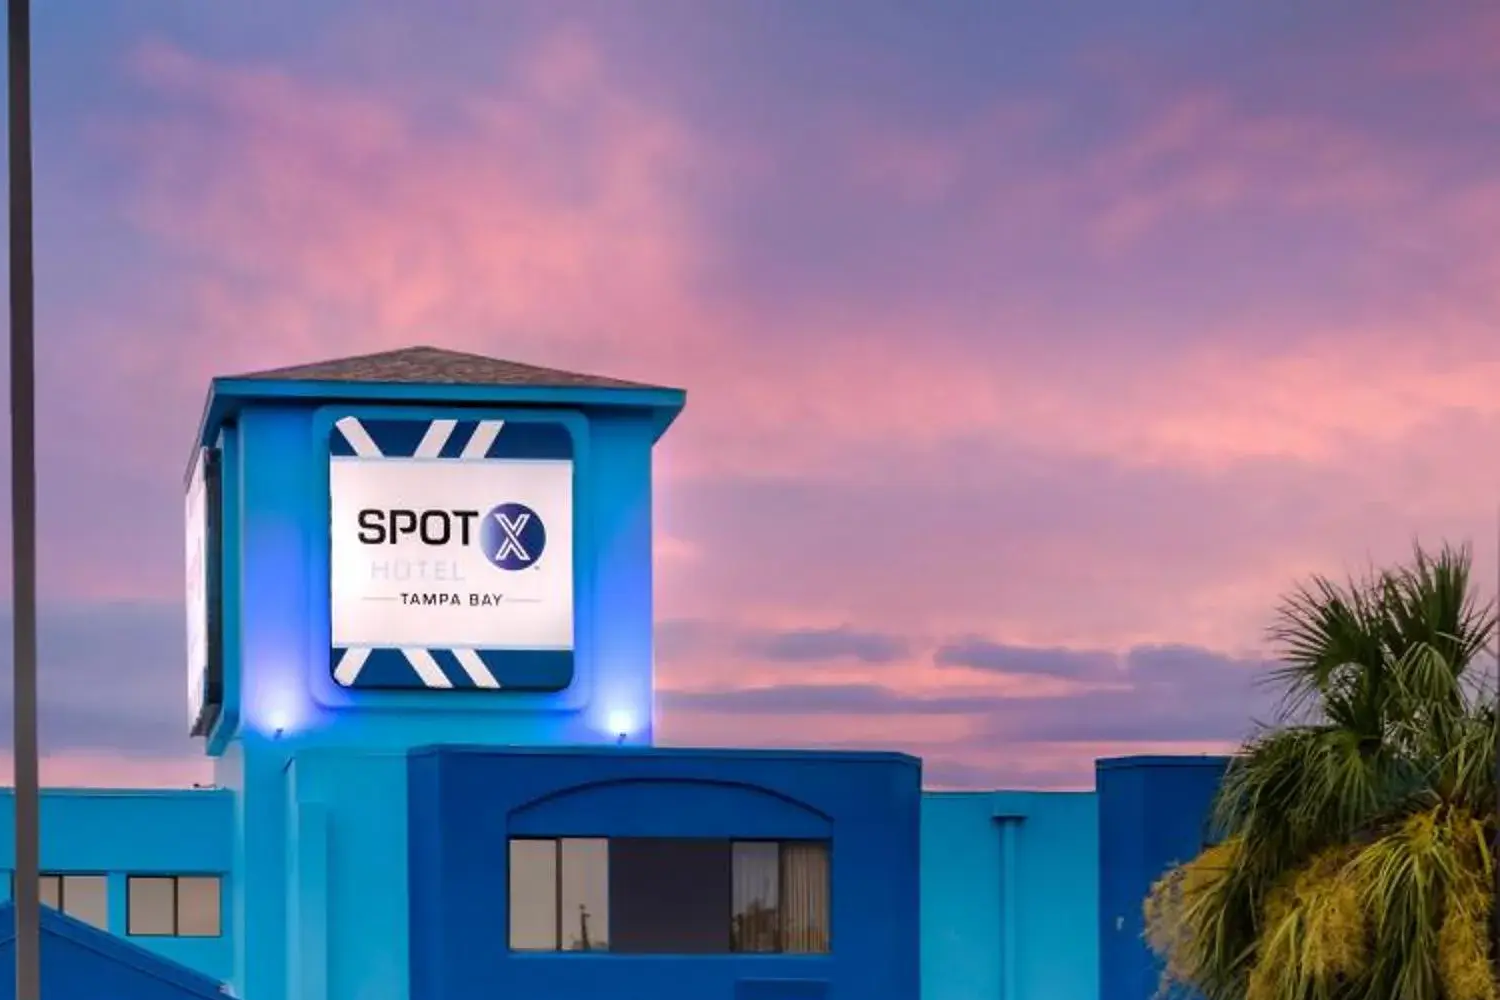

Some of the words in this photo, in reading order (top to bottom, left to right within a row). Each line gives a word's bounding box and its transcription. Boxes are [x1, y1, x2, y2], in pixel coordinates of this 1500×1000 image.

[357, 509, 479, 546] SPOT
[494, 512, 531, 561] X
[370, 559, 466, 582] HOTEL
[400, 592, 461, 607] TAMPA
[469, 593, 503, 607] BAY
